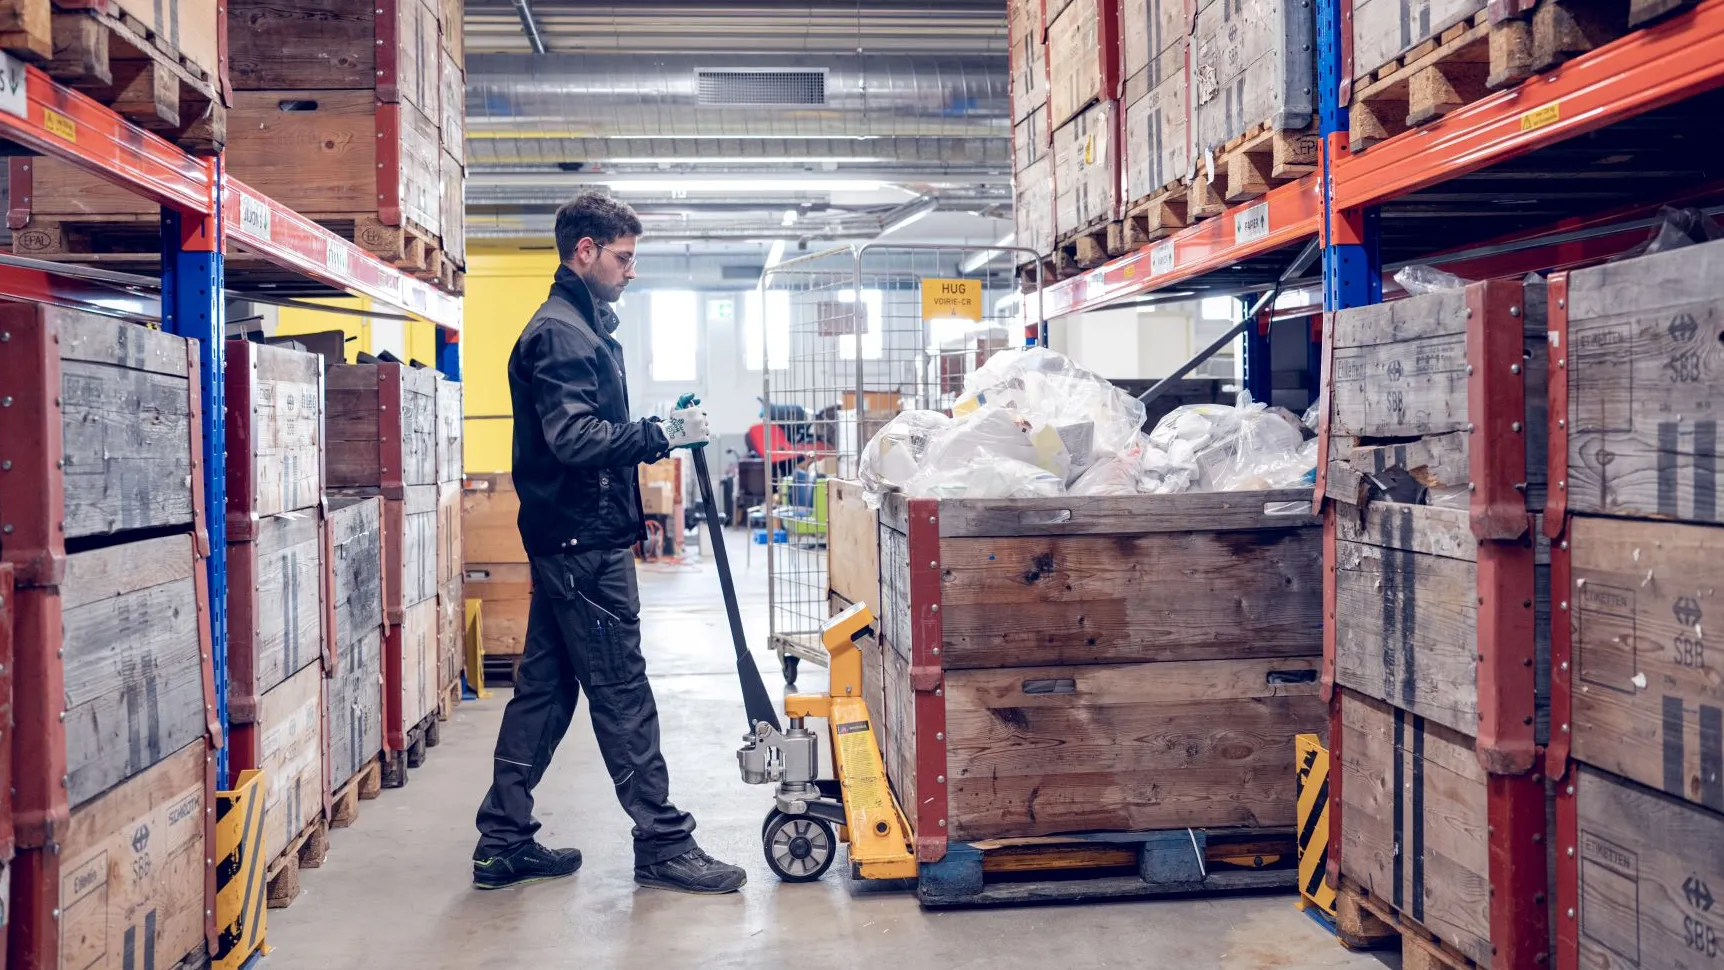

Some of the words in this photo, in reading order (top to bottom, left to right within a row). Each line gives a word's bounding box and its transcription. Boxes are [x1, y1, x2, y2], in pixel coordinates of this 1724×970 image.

[24, 235, 49, 246] EPAL
[942, 283, 966, 294] HUG
[1669, 352, 1699, 383] SBB
[1387, 391, 1403, 412] SBB
[1675, 636, 1704, 669] SBB
[133, 852, 150, 880] SBB
[1586, 838, 1631, 868] ETIKETTEN
[1684, 915, 1717, 958] SBB
